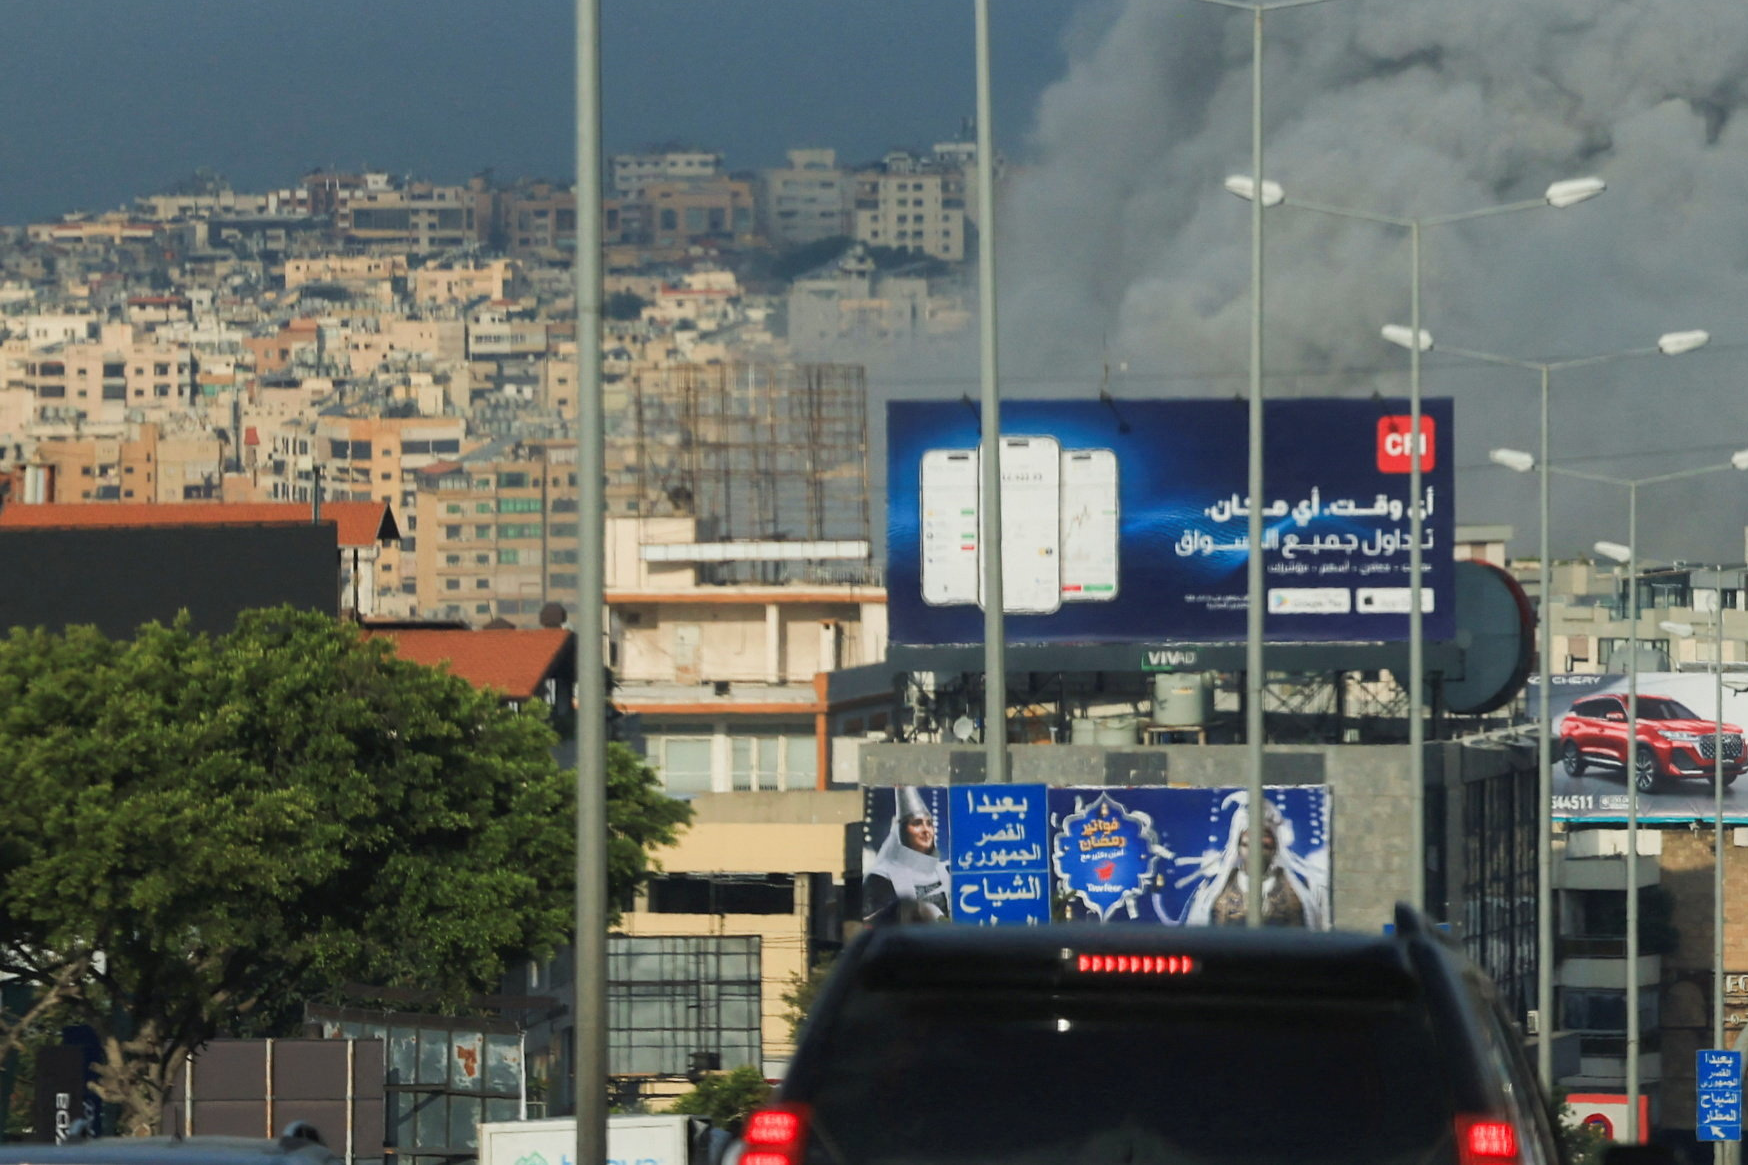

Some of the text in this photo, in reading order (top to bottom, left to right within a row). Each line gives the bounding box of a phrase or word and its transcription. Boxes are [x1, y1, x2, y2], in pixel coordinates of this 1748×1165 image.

[1204, 493, 1289, 522] مان.
[1291, 486, 1321, 526] أي
[1175, 527, 1280, 557] السواق
[1281, 533, 1358, 559] جميع
[1551, 675, 1602, 685] CHERY
[967, 789, 1029, 821] بعبدا
[974, 822, 1026, 847] القصر
[957, 842, 1042, 870] الجمهوري
[959, 874, 1042, 914] الشياح
[1705, 1052, 1733, 1067] بعبدا
[1700, 1091, 1738, 1109] الشياح
[1703, 1108, 1737, 1124] المطار
